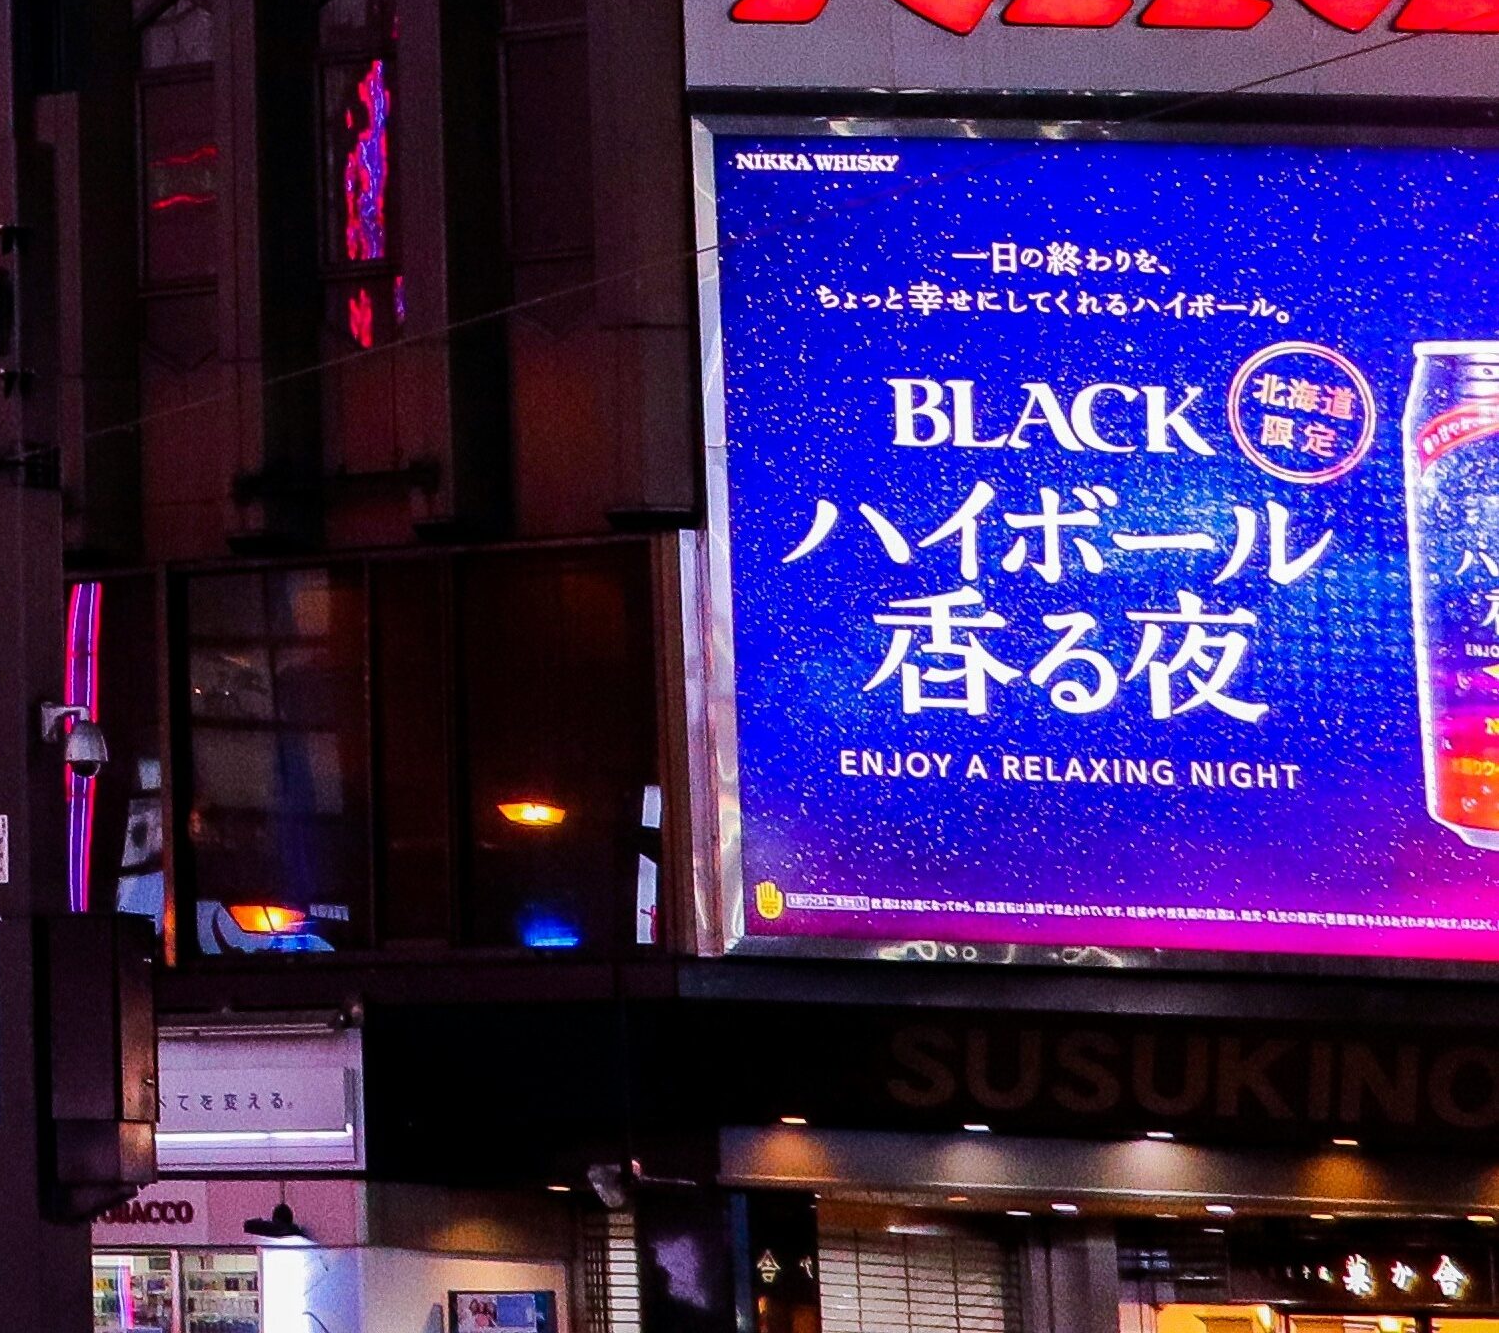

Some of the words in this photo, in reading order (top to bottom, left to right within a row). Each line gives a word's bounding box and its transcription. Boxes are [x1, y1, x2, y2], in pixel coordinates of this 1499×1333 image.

[735, 152, 813, 172] NIKKA
[814, 154, 900, 173] WHISKY
[952, 241, 1171, 278] 一日の終わりを、
[815, 284, 1292, 325] ちょっと幸せにしてくれるハイボール。
[888, 378, 1217, 457] BLACK
[1252, 373, 1356, 422] 北海道
[1259, 416, 1338, 458] 限定
[782, 480, 1335, 586] ハイボール
[864, 589, 1273, 725] 香る夜
[840, 749, 954, 779] ENJOY
[966, 752, 988, 779] A
[1002, 756, 1175, 787] RELAXING
[1190, 762, 1302, 791] NIGHT
